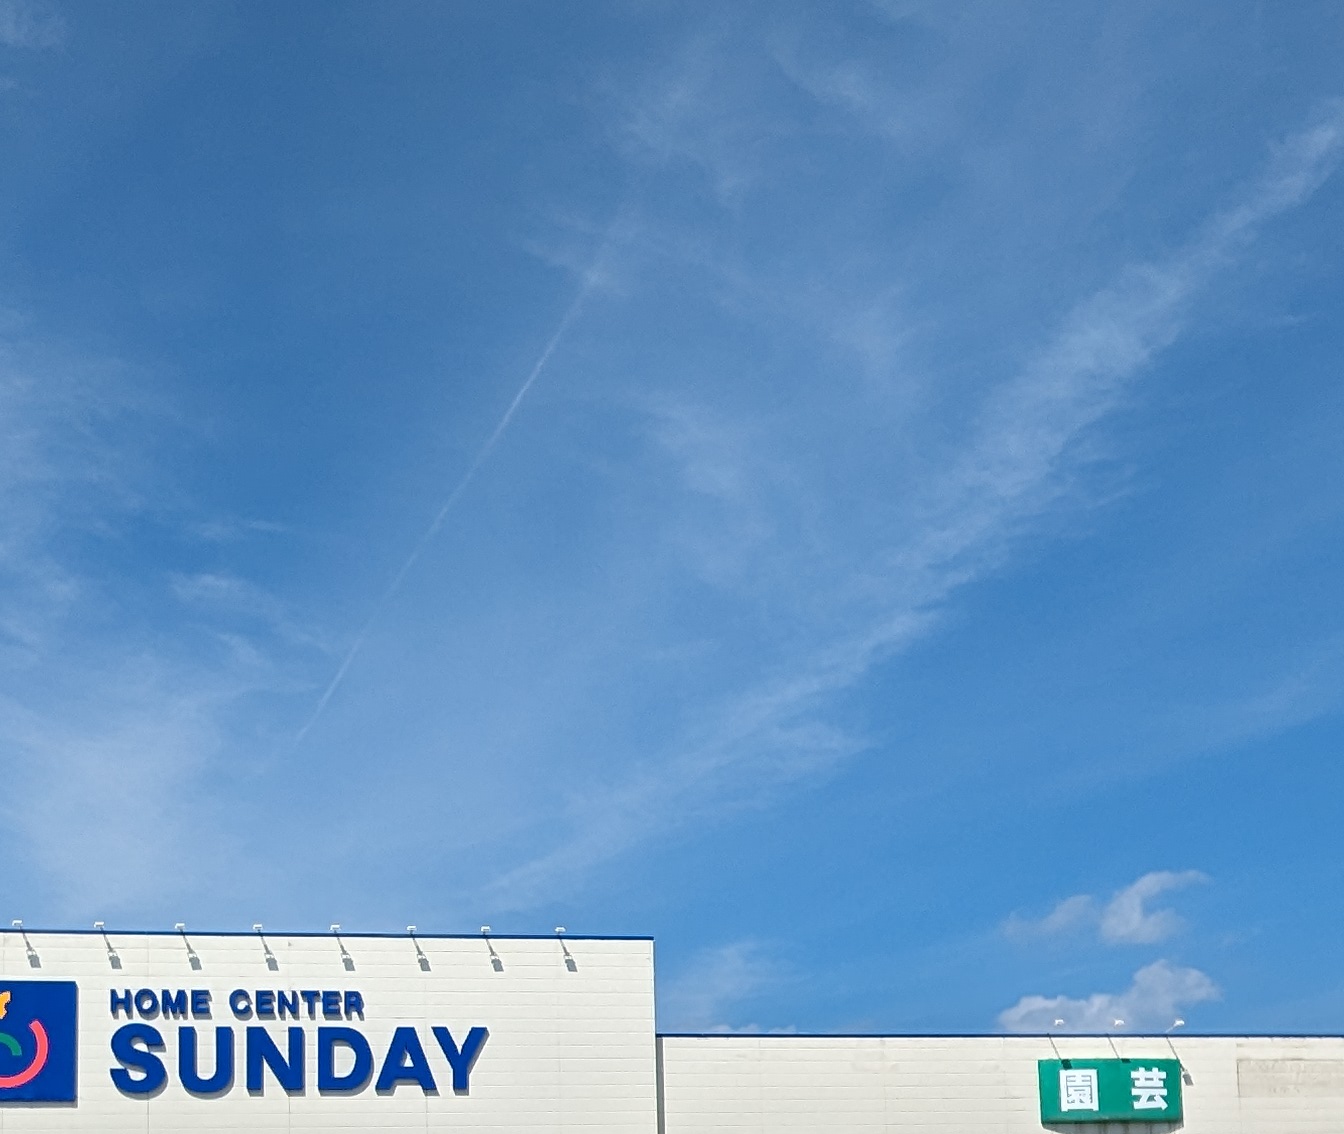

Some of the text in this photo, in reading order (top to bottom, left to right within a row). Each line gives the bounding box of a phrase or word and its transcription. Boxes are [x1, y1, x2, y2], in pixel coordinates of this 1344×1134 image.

[110, 989, 364, 1019] HOME CENTER
[110, 1025, 489, 1095] SUNDAY
[1058, 1067, 1168, 1112] 園芸
